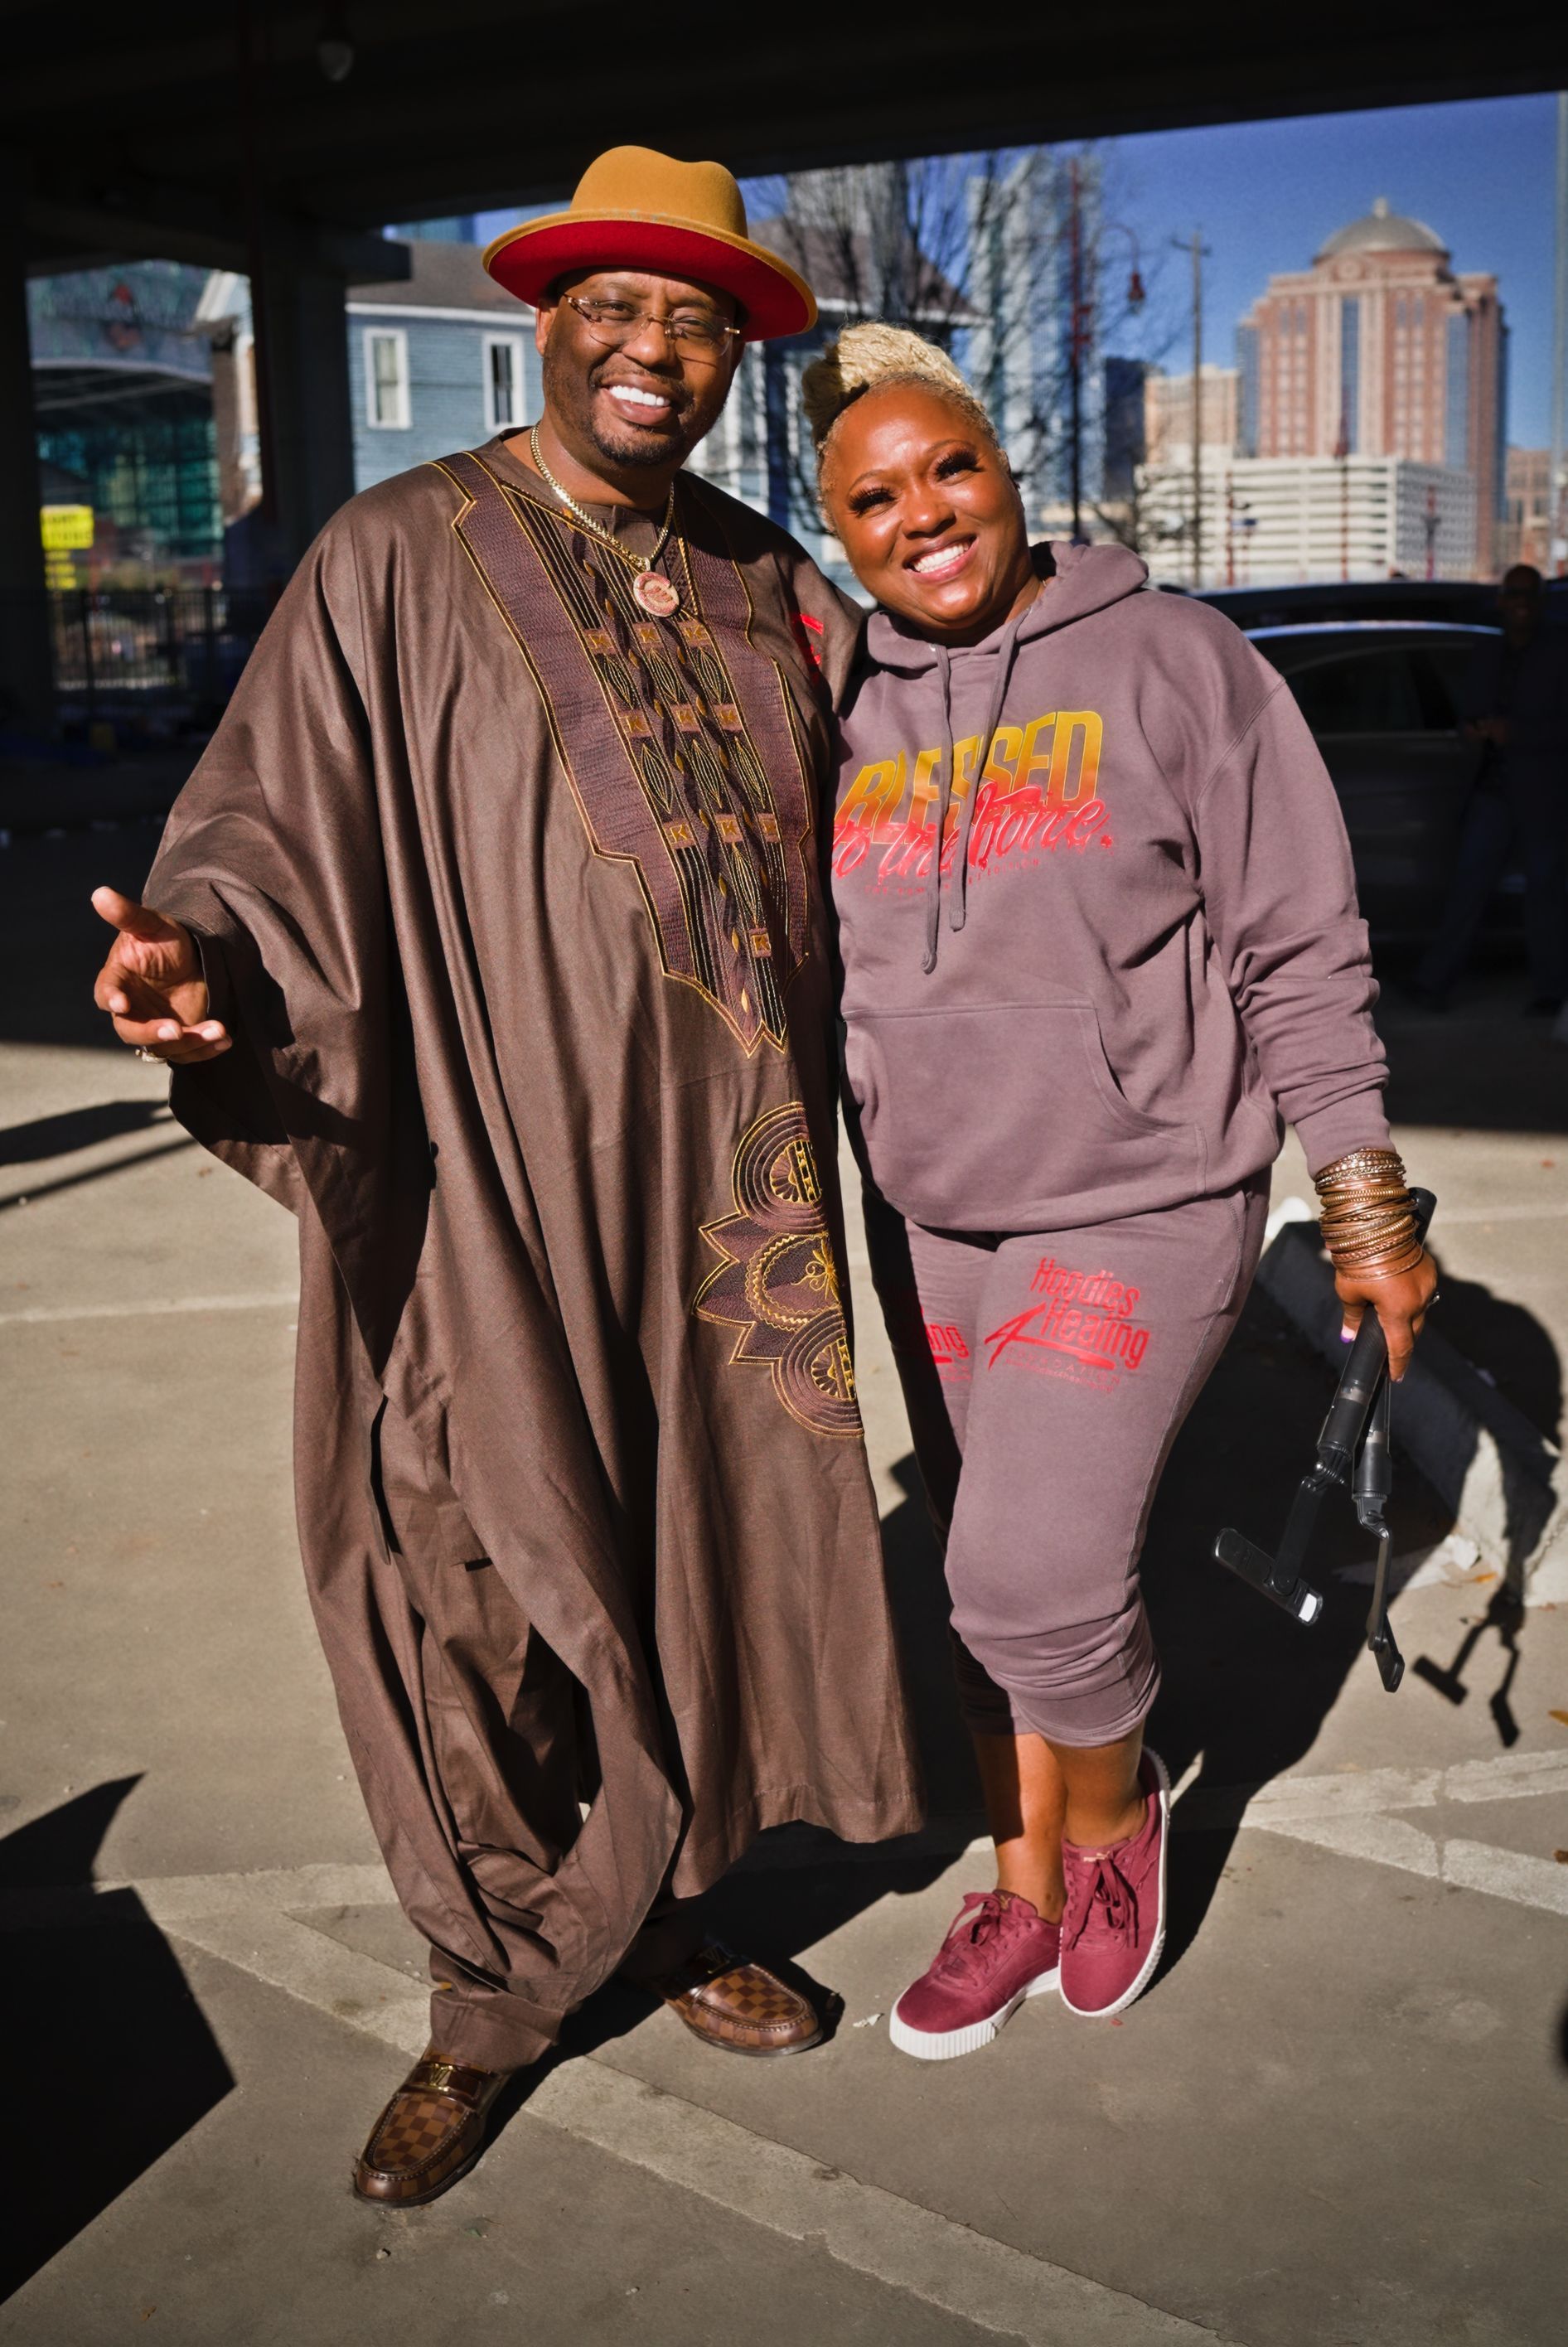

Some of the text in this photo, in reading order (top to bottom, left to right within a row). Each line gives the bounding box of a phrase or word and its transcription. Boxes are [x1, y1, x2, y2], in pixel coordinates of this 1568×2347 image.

[834, 710, 1103, 844] BLESSED
[877, 821, 960, 885] the
[1030, 1257, 1140, 1318] Hoodies
[1041, 1298, 1149, 1370] Healing
